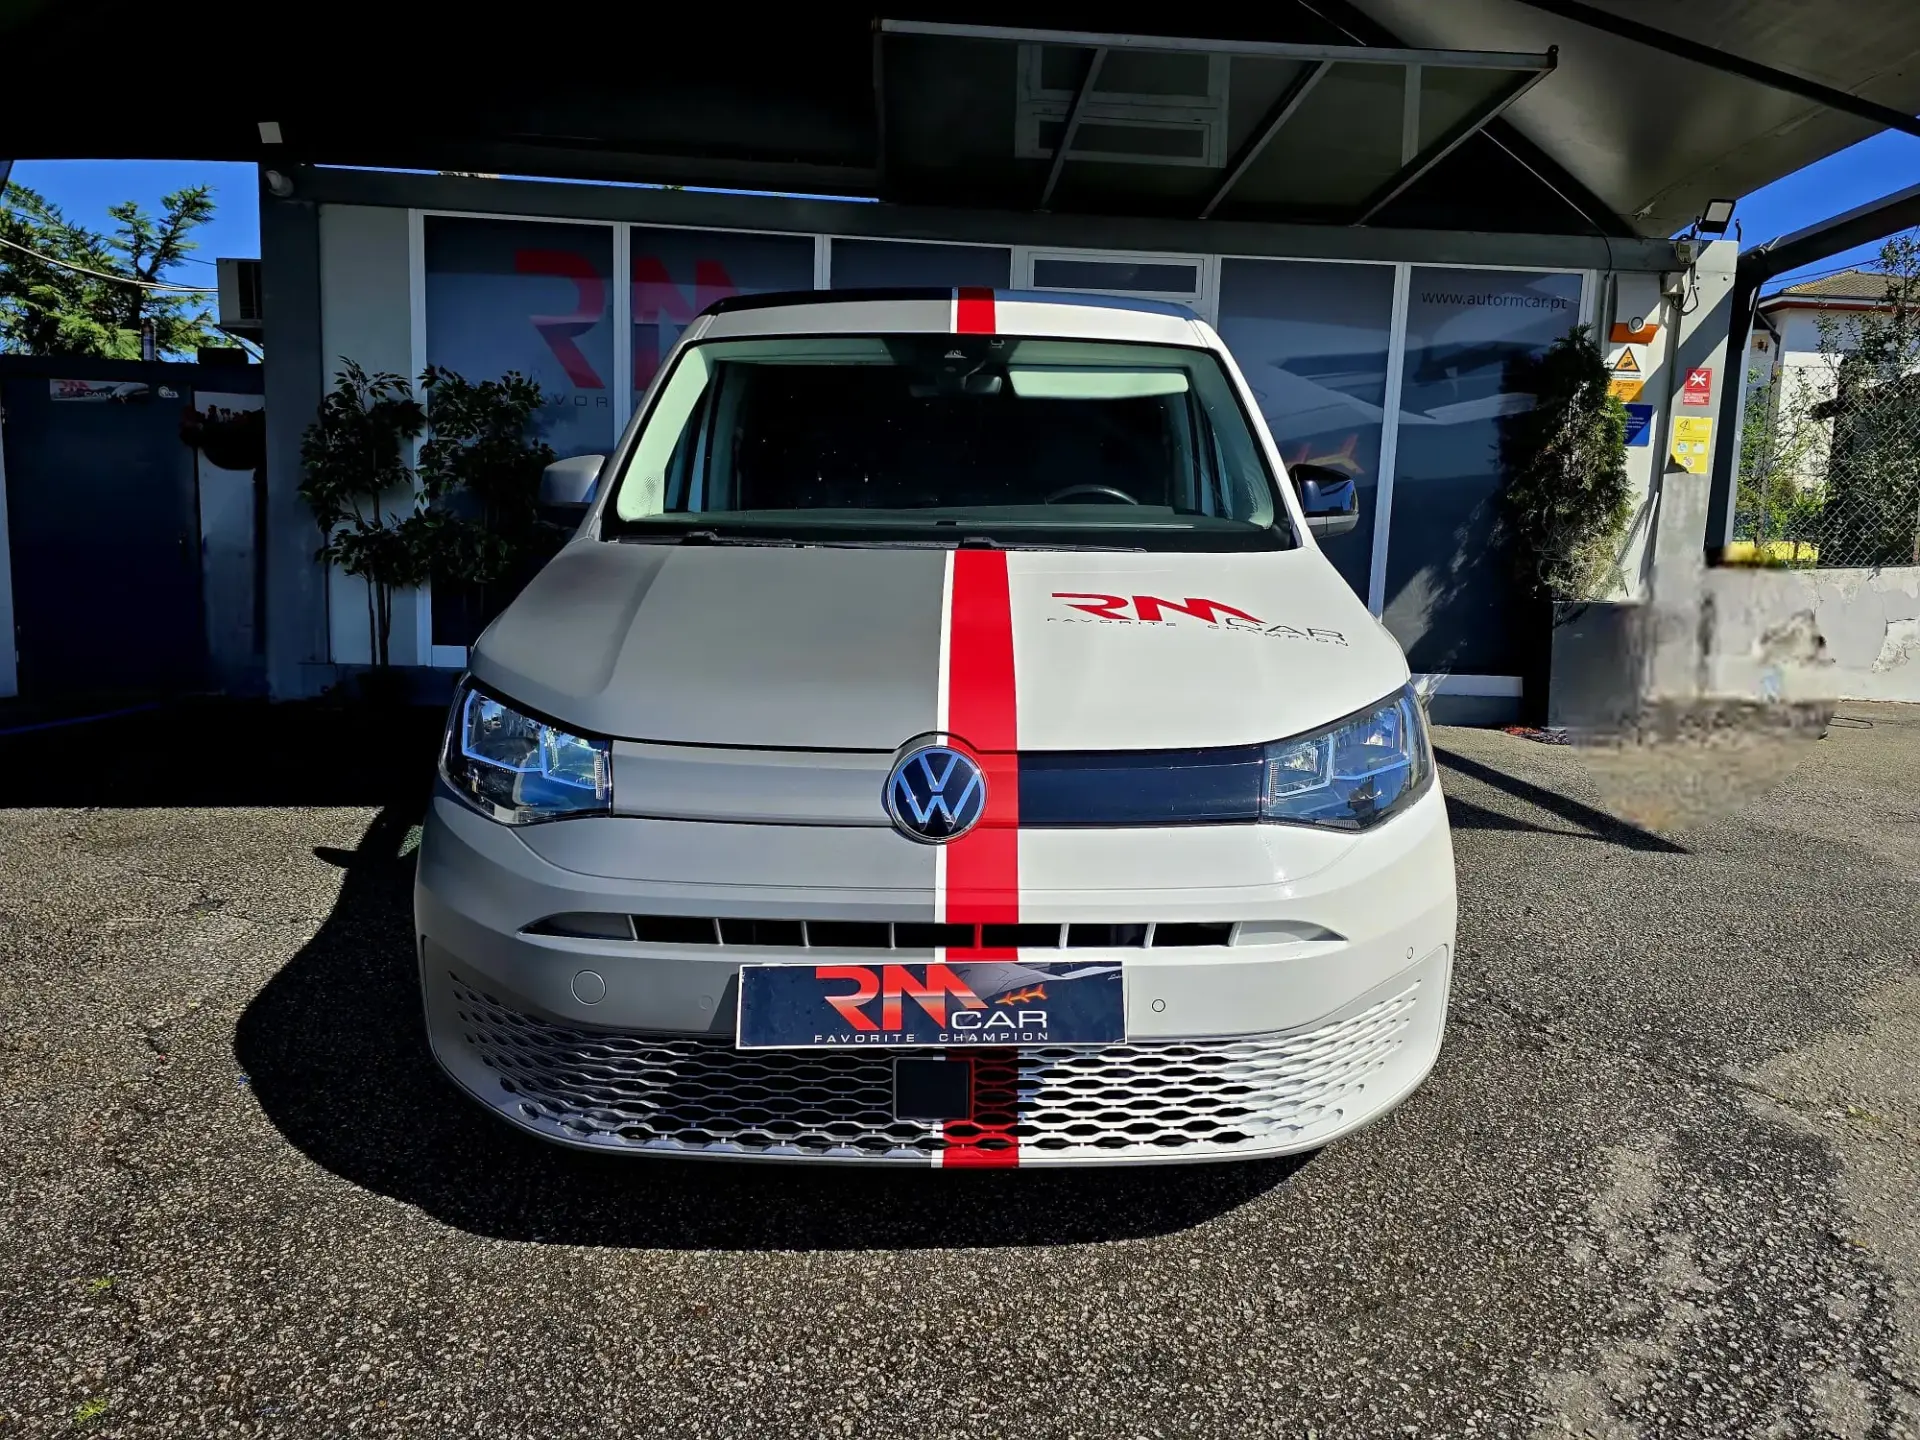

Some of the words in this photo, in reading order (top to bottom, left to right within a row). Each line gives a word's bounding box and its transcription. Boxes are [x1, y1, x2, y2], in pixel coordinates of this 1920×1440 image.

[1421, 291, 1568, 312] www.autormcar.pt
[1046, 616, 1178, 627] FAVORITE
[1207, 624, 1350, 647] CHAMPION
[1051, 592, 1266, 625] RM
[1225, 617, 1346, 642] CAR
[815, 964, 989, 1031] RM
[951, 1010, 1048, 1030] CAR
[813, 1033, 917, 1044] FAVORITE
[938, 1031, 1049, 1043] CHAMPION
